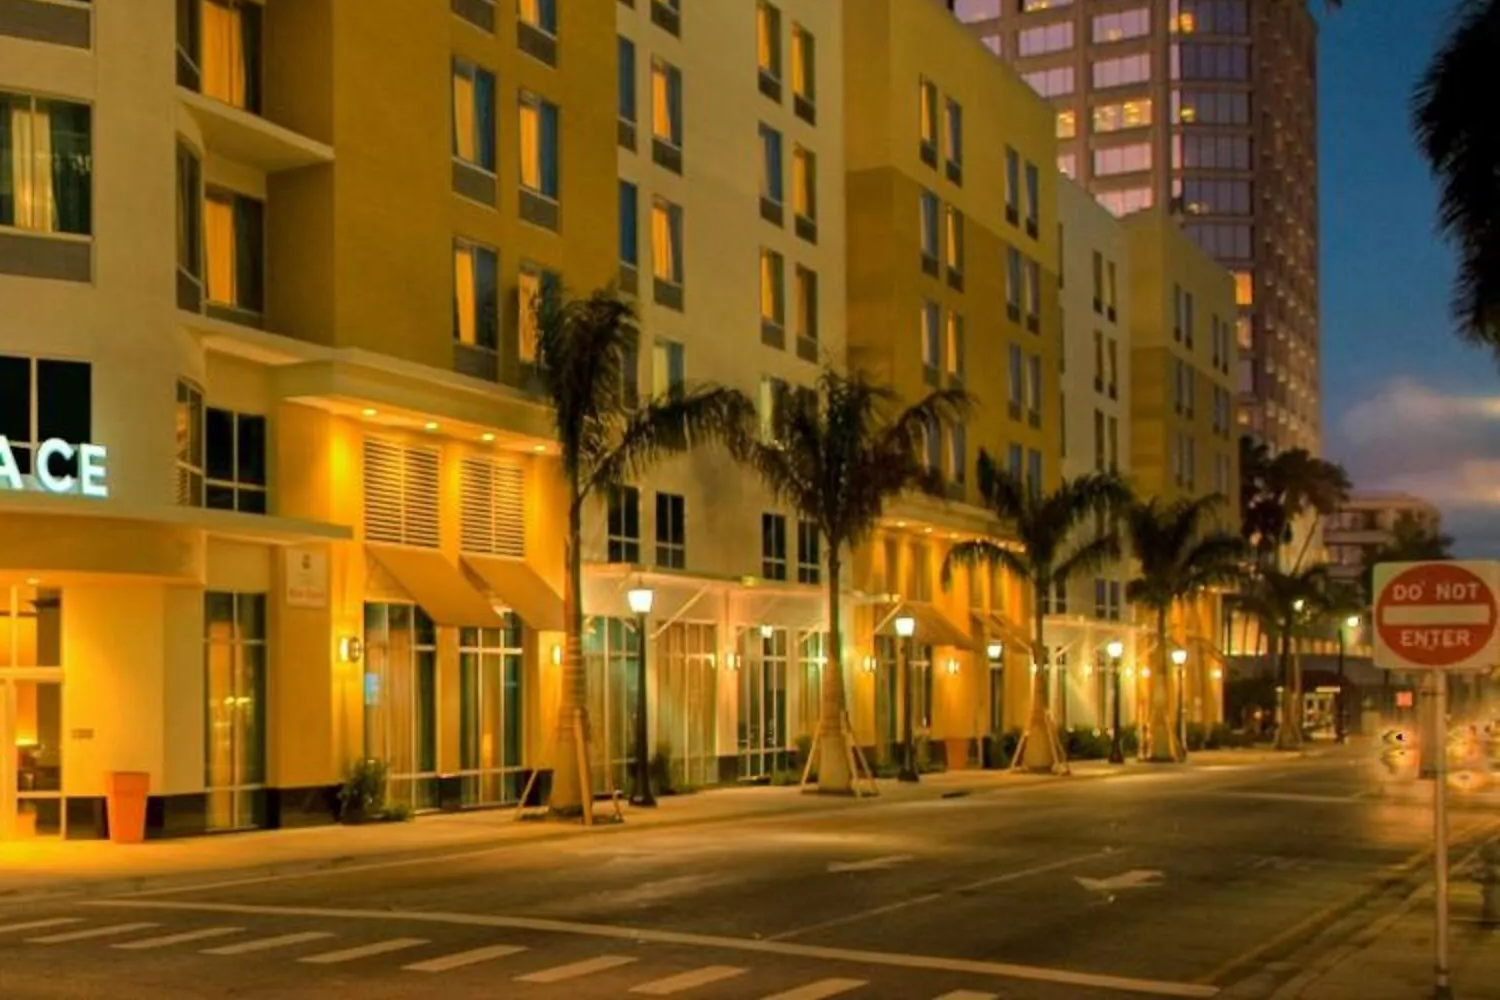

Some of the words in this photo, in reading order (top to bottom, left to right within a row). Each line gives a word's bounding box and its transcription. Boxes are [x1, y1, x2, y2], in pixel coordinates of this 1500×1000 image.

[1392, 583, 1423, 600] DO
[1436, 582, 1479, 600] NOT
[1401, 629, 1471, 647] ENTER
